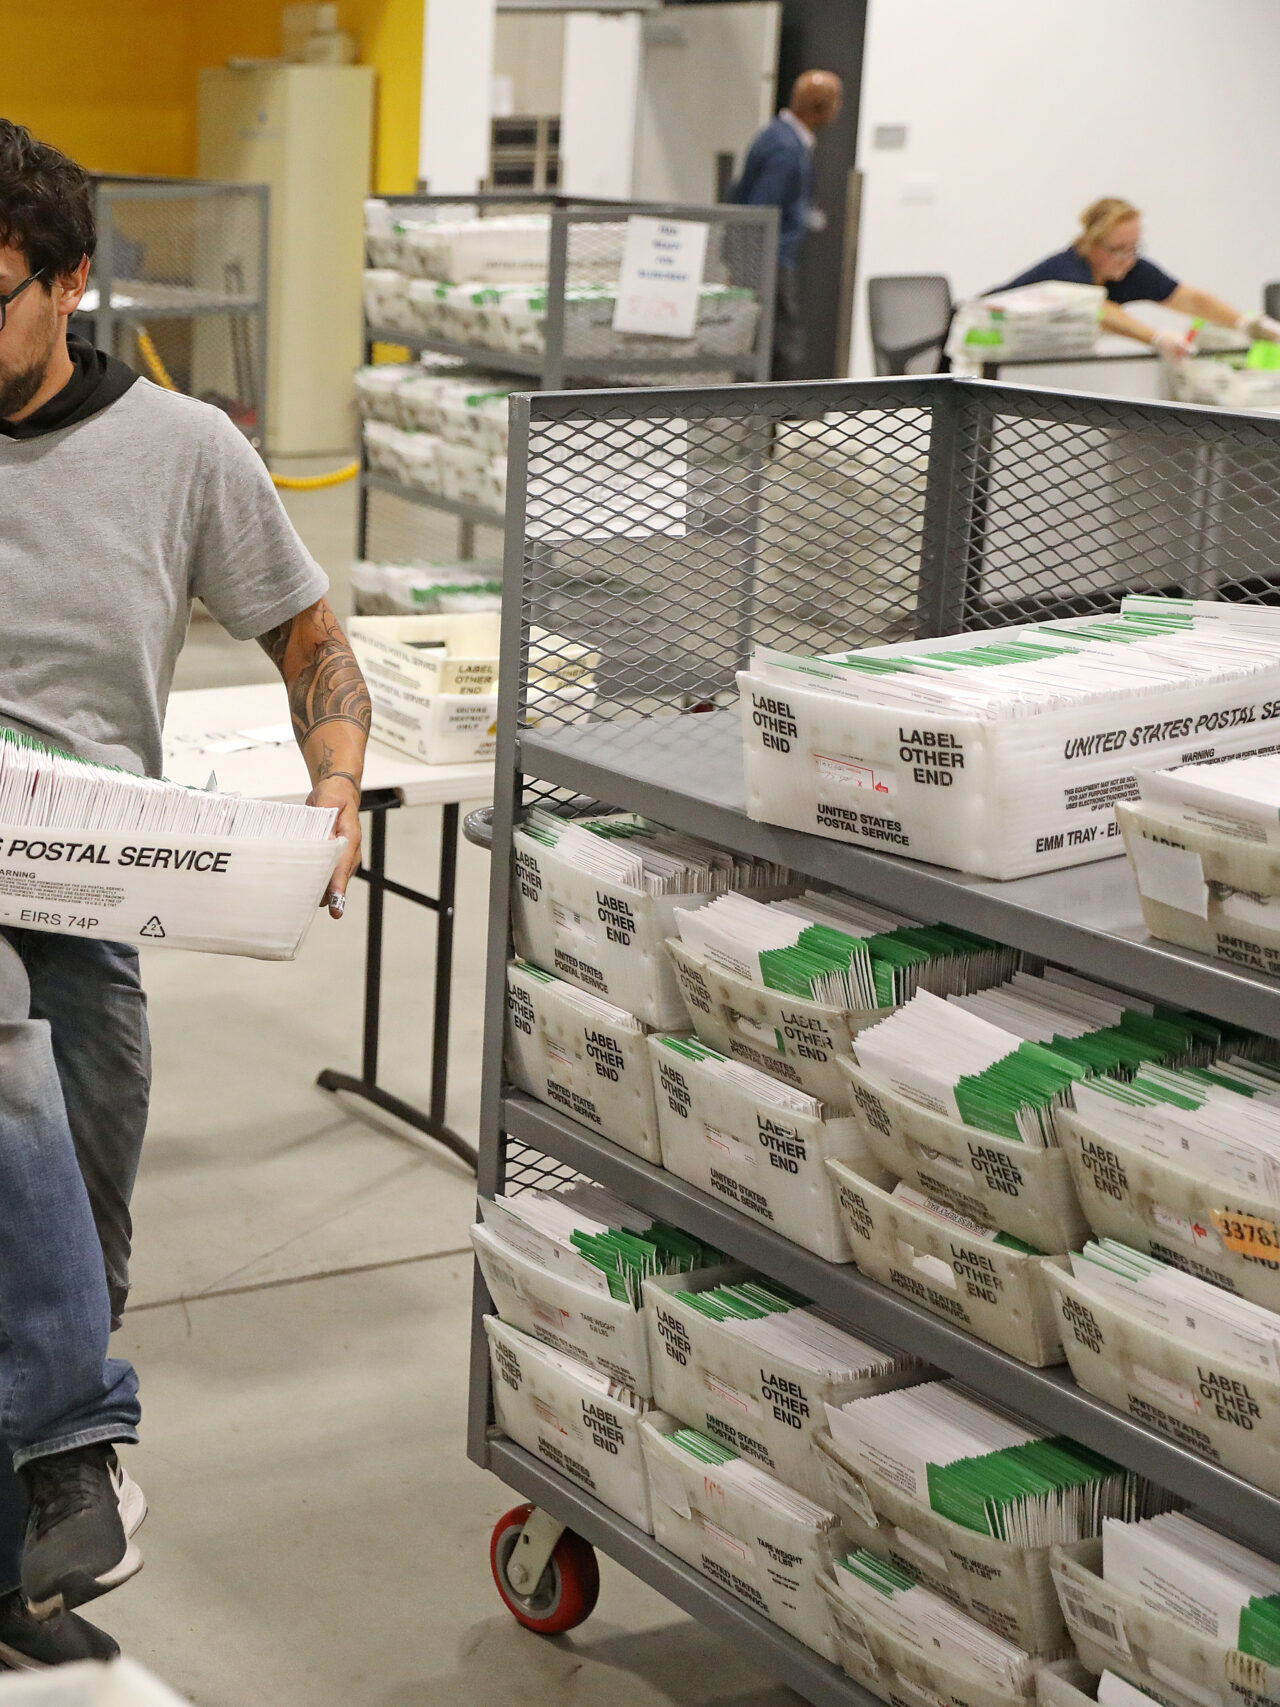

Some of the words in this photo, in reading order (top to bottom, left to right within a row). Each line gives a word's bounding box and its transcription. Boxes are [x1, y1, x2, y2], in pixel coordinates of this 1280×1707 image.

[454, 676, 492, 684] OTHER
[458, 665, 493, 674] LABEL
[459, 687, 482, 695] END
[752, 692, 796, 720] LABEL
[753, 711, 798, 738] OTHER
[899, 727, 963, 749] LABEL
[1064, 730, 1127, 760] UNITED
[1129, 717, 1194, 747] STATES
[1194, 705, 1256, 734] POSTAL
[762, 732, 791, 754] END
[1182, 748, 1215, 763] WARNING
[899, 746, 965, 769] OTHER
[913, 768, 953, 787] END
[816, 815, 859, 835] POSTAL
[861, 826, 910, 847] SERVICE
[817, 803, 858, 822] UNITED
[860, 814, 903, 832] STATES
[1036, 834, 1064, 853] EMM
[1067, 826, 1098, 846] TRAY
[7, 839, 111, 865] POSTAL
[117, 846, 232, 874] SERVICE
[514, 848, 541, 873] LABEL
[515, 863, 543, 890] OTHER
[521, 882, 539, 902] END
[596, 891, 634, 916] LABEL
[20, 909, 62, 926] EIRS
[67, 916, 100, 930] 74P
[597, 909, 636, 934] OTHER
[606, 927, 631, 946] END
[554, 948, 578, 967] UNITED
[578, 961, 604, 980] STATES
[554, 959, 580, 979] POSTAL
[581, 973, 609, 994] SERVICE
[677, 960, 707, 988] LABEL
[507, 982, 534, 1007] LABEL
[680, 974, 713, 1003] OTHER
[508, 996, 535, 1024] OTHER
[690, 995, 710, 1014] END
[513, 1015, 532, 1035] END
[781, 1010, 829, 1033] LABEL
[584, 1027, 623, 1054] LABEL
[784, 1026, 834, 1050] OTHER
[585, 1044, 625, 1070] OTHER
[797, 1044, 828, 1063] END
[595, 1062, 619, 1082] END
[658, 1060, 689, 1090] LABEL
[547, 1079, 571, 1098] UNITED
[571, 1091, 596, 1112] STATES
[660, 1076, 692, 1108] OTHER
[851, 1080, 887, 1114] LABEL
[547, 1089, 572, 1109] POSTAL
[573, 1102, 602, 1126] SERVICE
[668, 1096, 688, 1119] END
[855, 1094, 893, 1129] OTHER
[868, 1112, 891, 1137] END
[758, 1131, 807, 1161] OTHER
[967, 1142, 1018, 1171] LABEL
[1079, 1136, 1125, 1174] LABEL
[769, 1152, 799, 1175] END
[971, 1157, 1024, 1187] OTHER
[1081, 1152, 1130, 1191] OTHER
[710, 1168, 738, 1190] UNITED
[738, 1183, 768, 1207] STATES
[711, 1178, 740, 1201] POSTAL
[740, 1194, 774, 1221] SERVICE
[984, 1175, 1019, 1197] END
[1093, 1174, 1123, 1200] END
[950, 1243, 997, 1273] LABEL
[953, 1260, 1004, 1292] OTHER
[967, 1281, 998, 1305] END
[656, 1305, 690, 1340] LABEL
[1060, 1294, 1098, 1328] LABEL
[1062, 1305, 1105, 1345] OTHER
[494, 1336, 521, 1367] LABEL
[657, 1322, 692, 1356] OTHER
[1073, 1326, 1101, 1354] END
[495, 1349, 522, 1382] OTHER
[665, 1343, 687, 1366] END
[501, 1367, 519, 1391] END
[760, 1369, 808, 1402] LABEL
[1197, 1366, 1255, 1401] LABEL
[581, 1398, 623, 1430] LABEL
[761, 1386, 811, 1419] OTHER
[1199, 1383, 1263, 1419] OTHER
[582, 1414, 625, 1445] OTHER
[773, 1406, 802, 1430] END
[1215, 1405, 1254, 1431] END
[593, 1434, 618, 1455] END
[706, 1413, 736, 1436] UNITED
[738, 1430, 769, 1456] STATES
[707, 1422, 738, 1448] POSTAL
[739, 1441, 776, 1470] SERVICE
